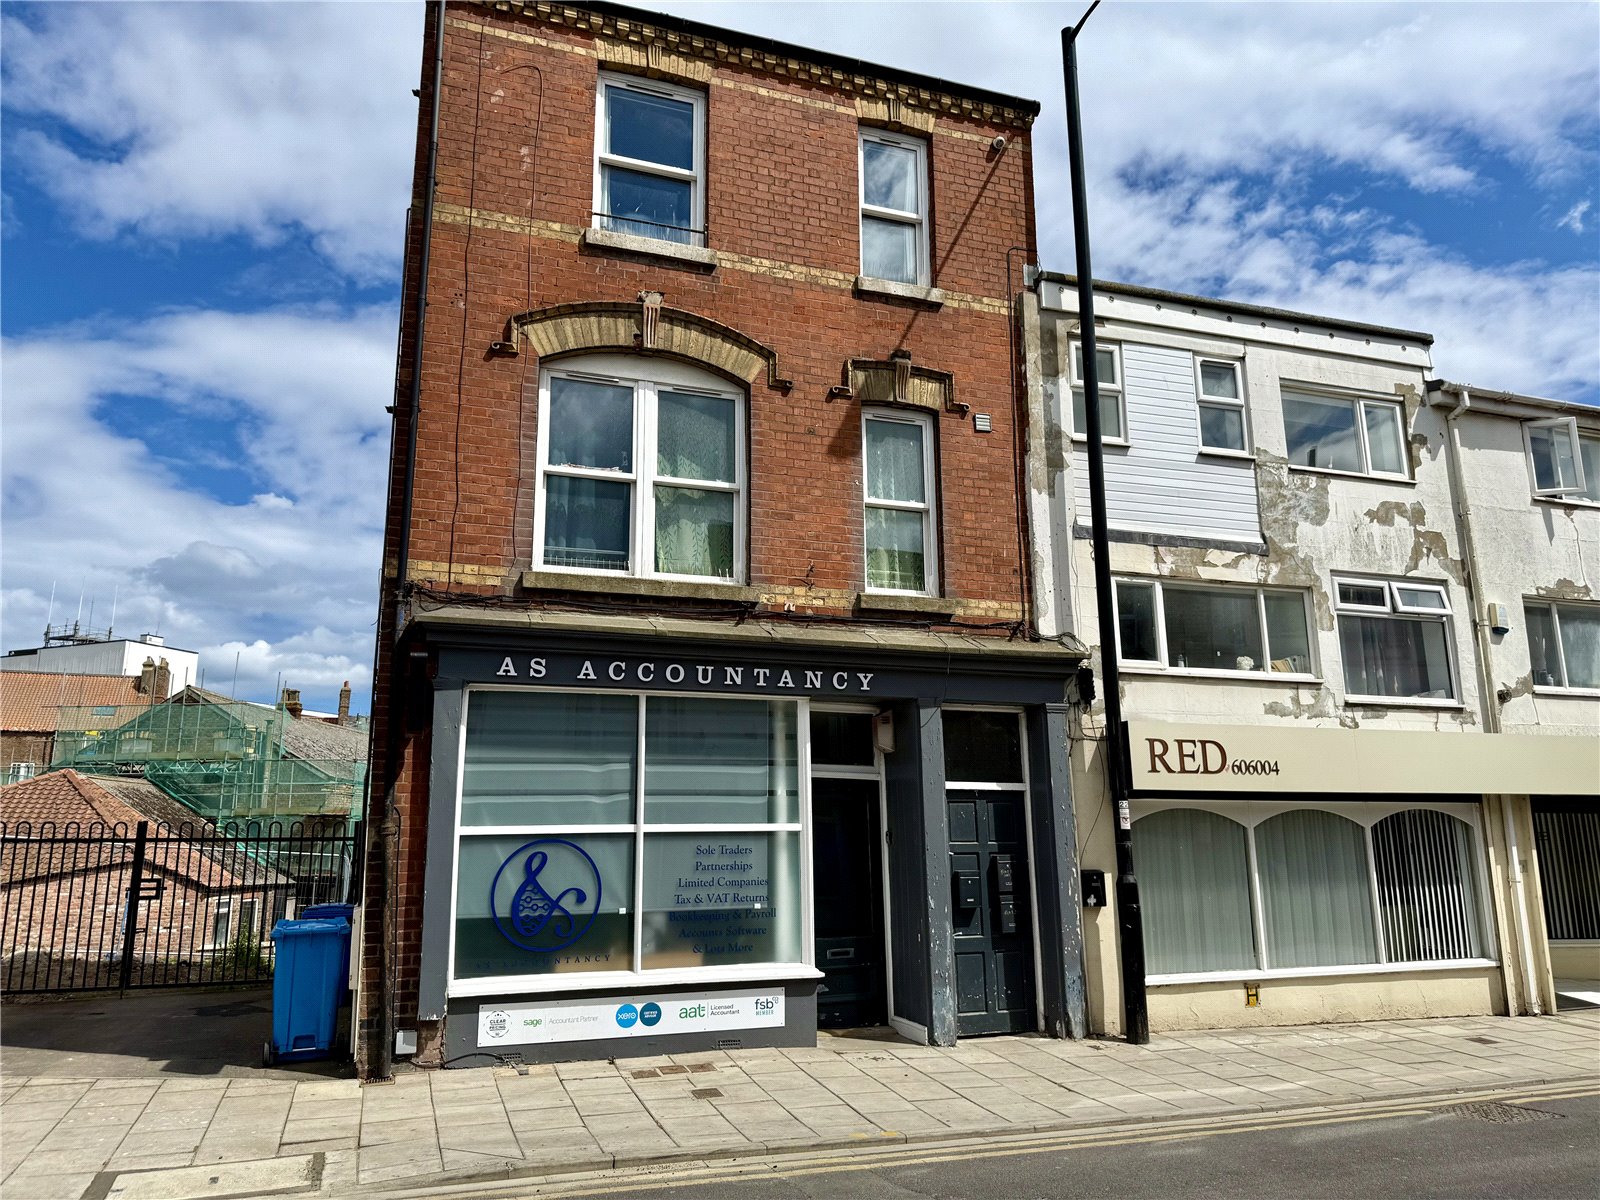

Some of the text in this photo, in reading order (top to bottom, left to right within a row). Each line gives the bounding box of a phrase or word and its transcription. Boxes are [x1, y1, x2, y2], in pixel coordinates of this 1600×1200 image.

[497, 656, 873, 690] AS ACCOUNTANCY
[1145, 738, 1280, 775] RED 606004
[696, 844, 753, 855] Sole Traders
[695, 860, 753, 873] Partnerships
[678, 876, 769, 888] Limited Companies
[674, 892, 769, 904] Tax & VAT Returns
[732, 910, 743, 920] &
[745, 908, 777, 921] Payroll
[726, 925, 767, 937] Software
[693, 944, 703, 954] &
[728, 942, 753, 953] More
[755, 999, 774, 1010] fsb
[618, 1012, 637, 1020] xero
[679, 1004, 706, 1019] aat
[523, 1018, 543, 1028] sage
[548, 1016, 579, 1024] Accountant
